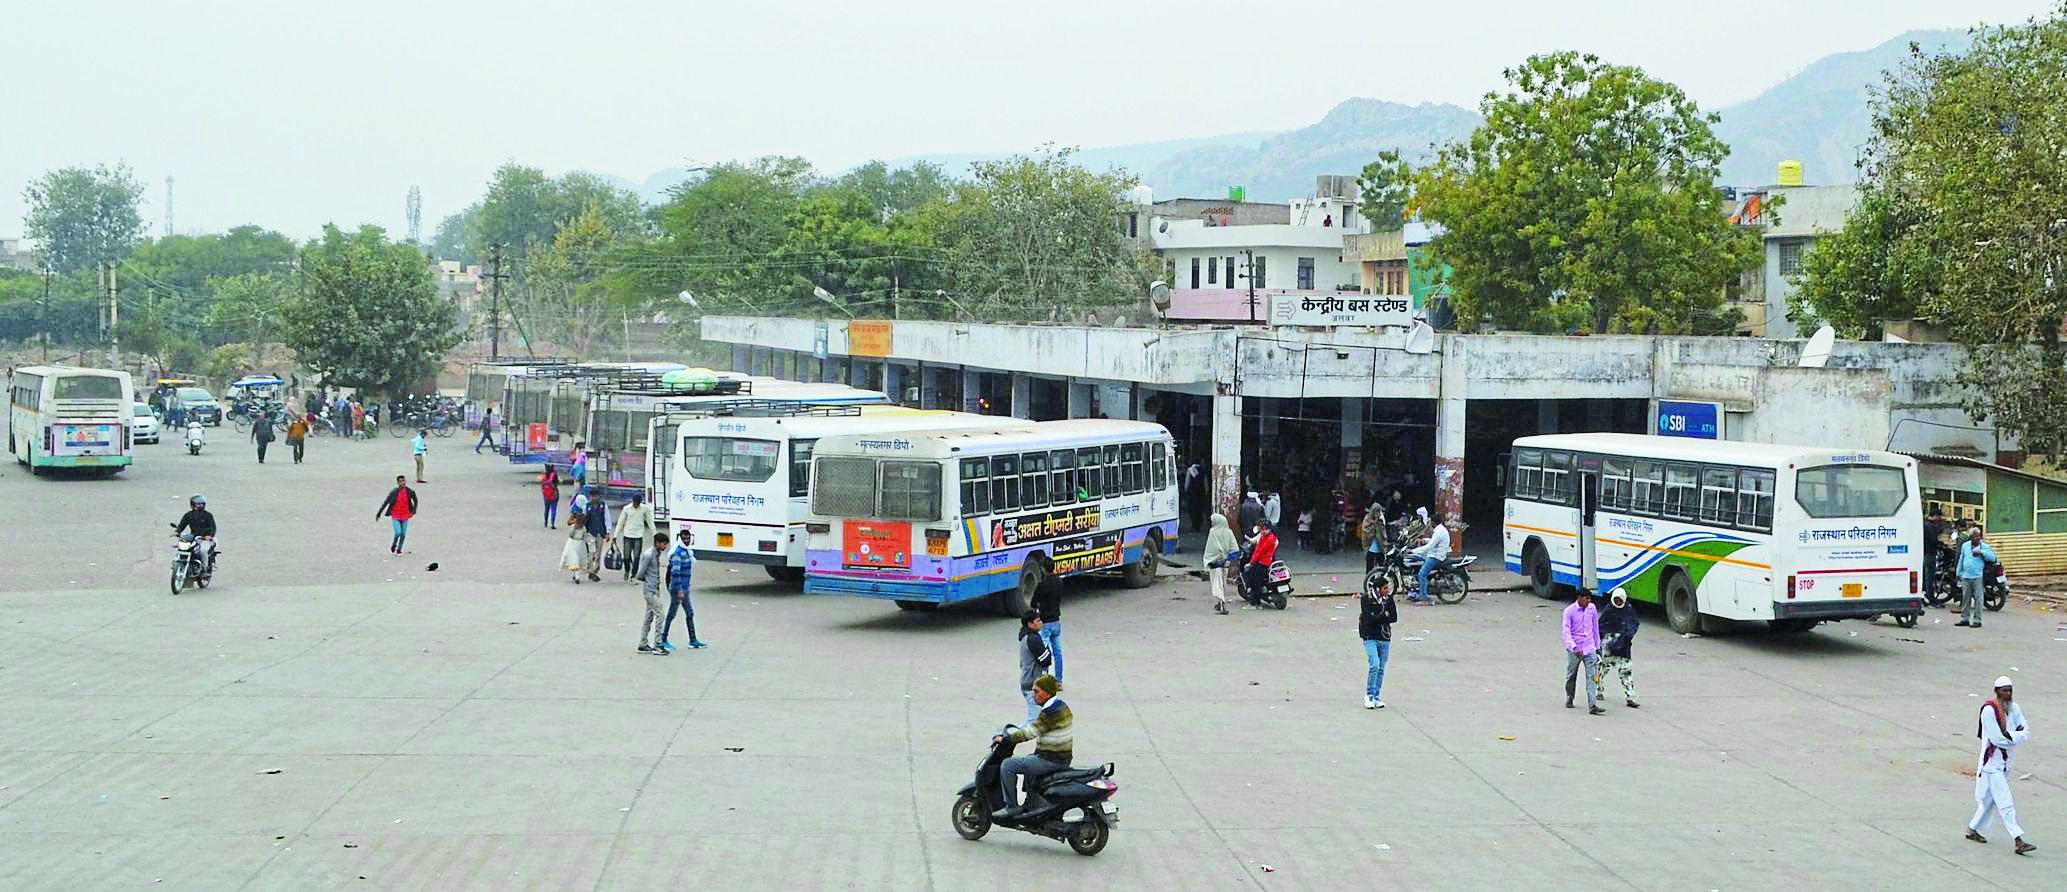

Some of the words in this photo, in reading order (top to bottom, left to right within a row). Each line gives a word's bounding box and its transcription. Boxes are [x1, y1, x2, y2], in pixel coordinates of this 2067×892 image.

[1301, 296, 1344, 315] केन्द्रीय
[1348, 299, 1369, 312] बस
[1669, 415, 1686, 432] SBI
[692, 493, 720, 504] राजस्थान
[721, 492, 746, 506] परिवहन
[747, 494, 765, 507] निगम
[1018, 521, 1042, 539] अक्षत
[1812, 529, 1846, 541] राजस्थान
[1847, 526, 1876, 540] परिवहन
[1877, 525, 1897, 539] निगम
[1080, 554, 1095, 569] TMT
[1095, 550, 1114, 566] BARS
[1799, 579, 1815, 590] STOP
